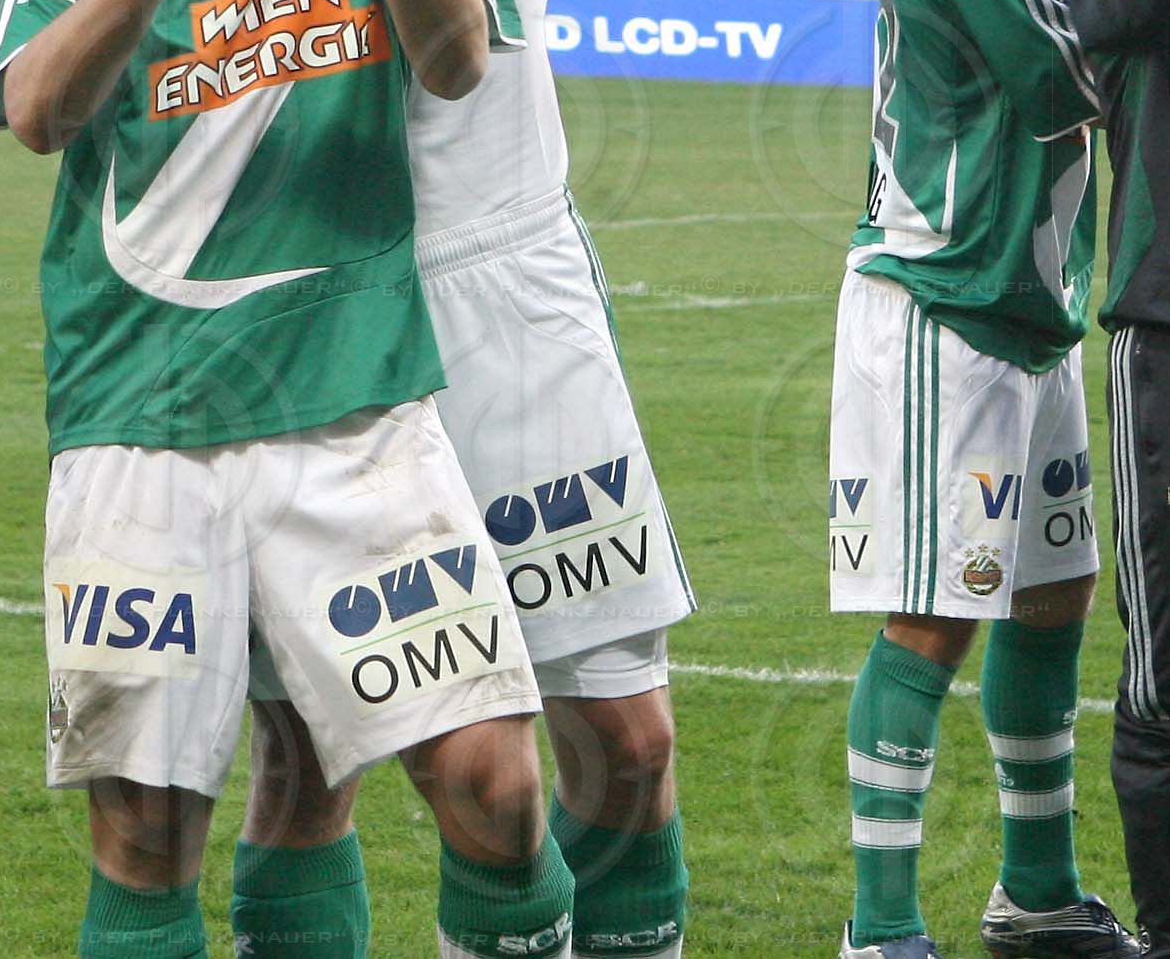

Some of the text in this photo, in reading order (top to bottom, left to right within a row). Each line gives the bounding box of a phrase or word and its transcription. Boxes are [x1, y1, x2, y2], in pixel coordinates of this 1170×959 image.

[593, 15, 782, 58] LCD-TV
[507, 525, 646, 610] OMV
[53, 583, 196, 655] VISA
[352, 615, 498, 704] OMV
